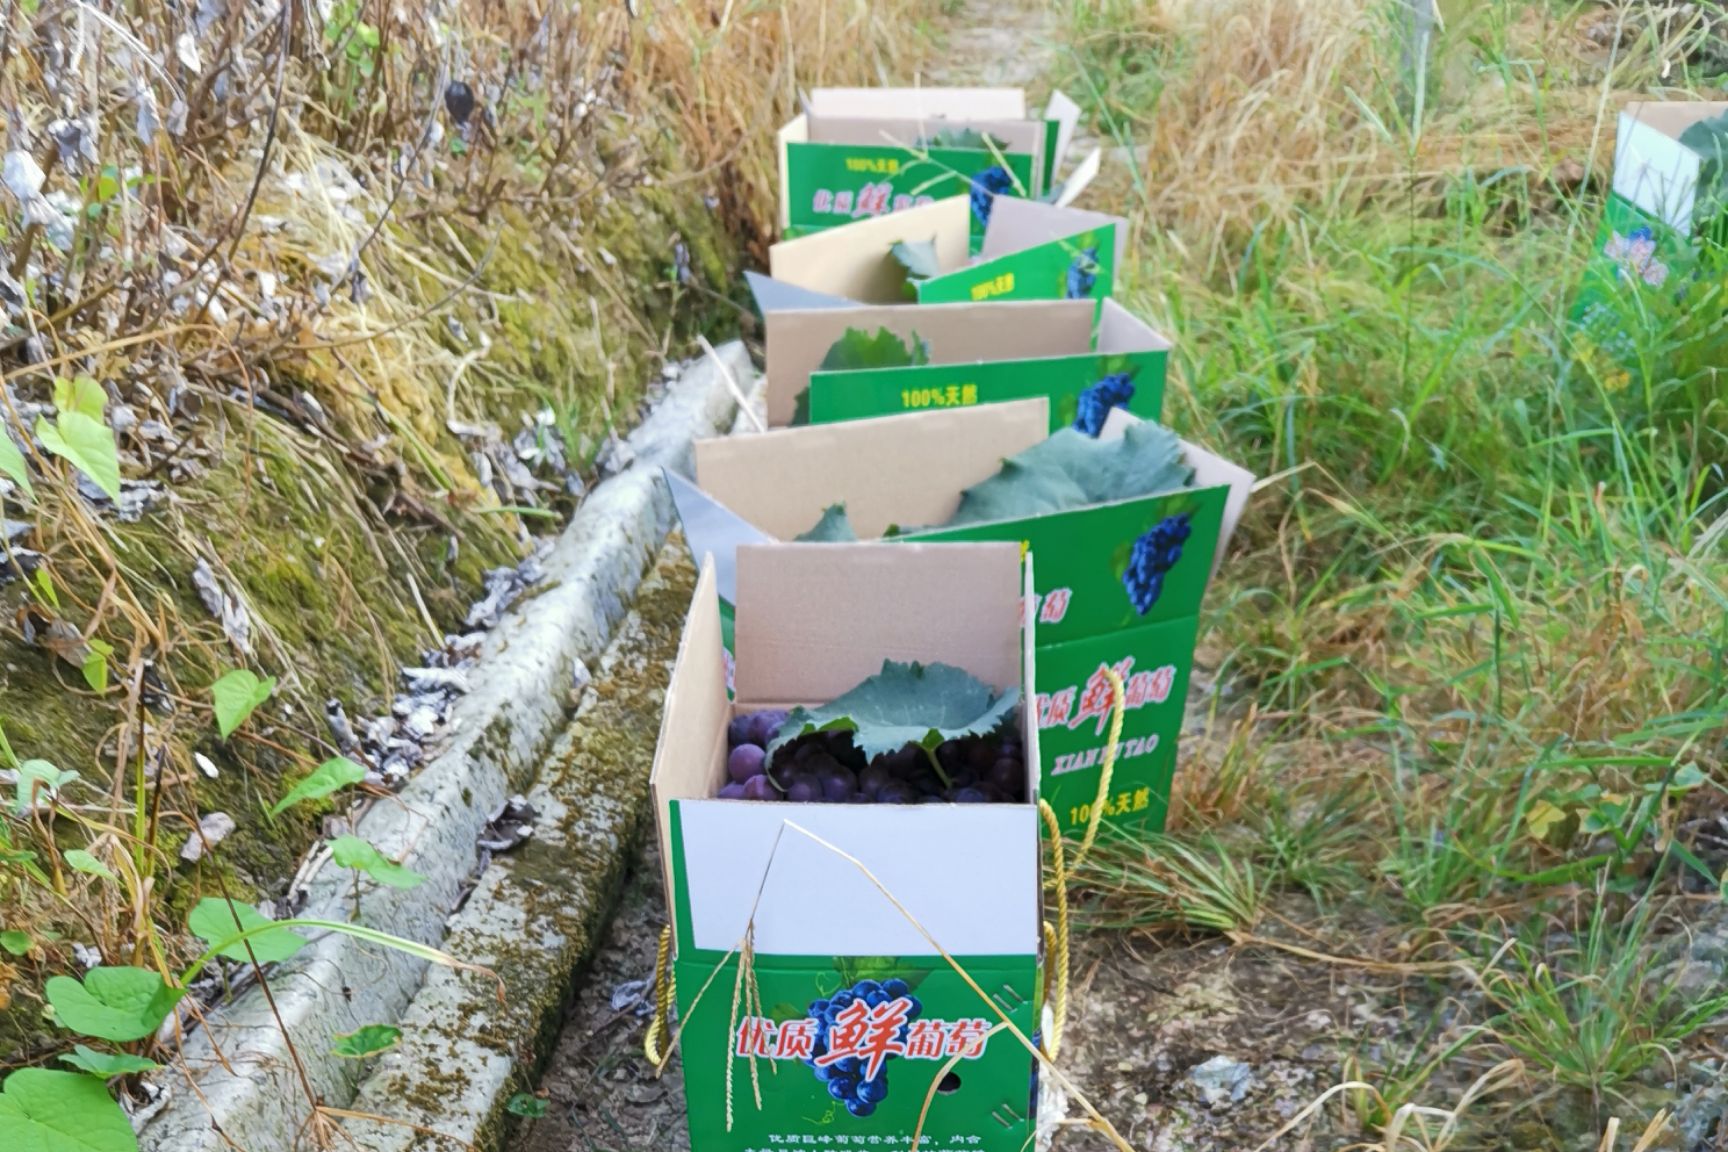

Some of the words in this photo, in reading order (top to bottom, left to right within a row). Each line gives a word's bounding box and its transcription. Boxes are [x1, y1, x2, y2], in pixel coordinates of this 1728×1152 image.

[901, 383, 978, 408] 100%天然
[1070, 786, 1150, 826] 10%天然
[736, 998, 992, 1082] 优质鲜葡萄
